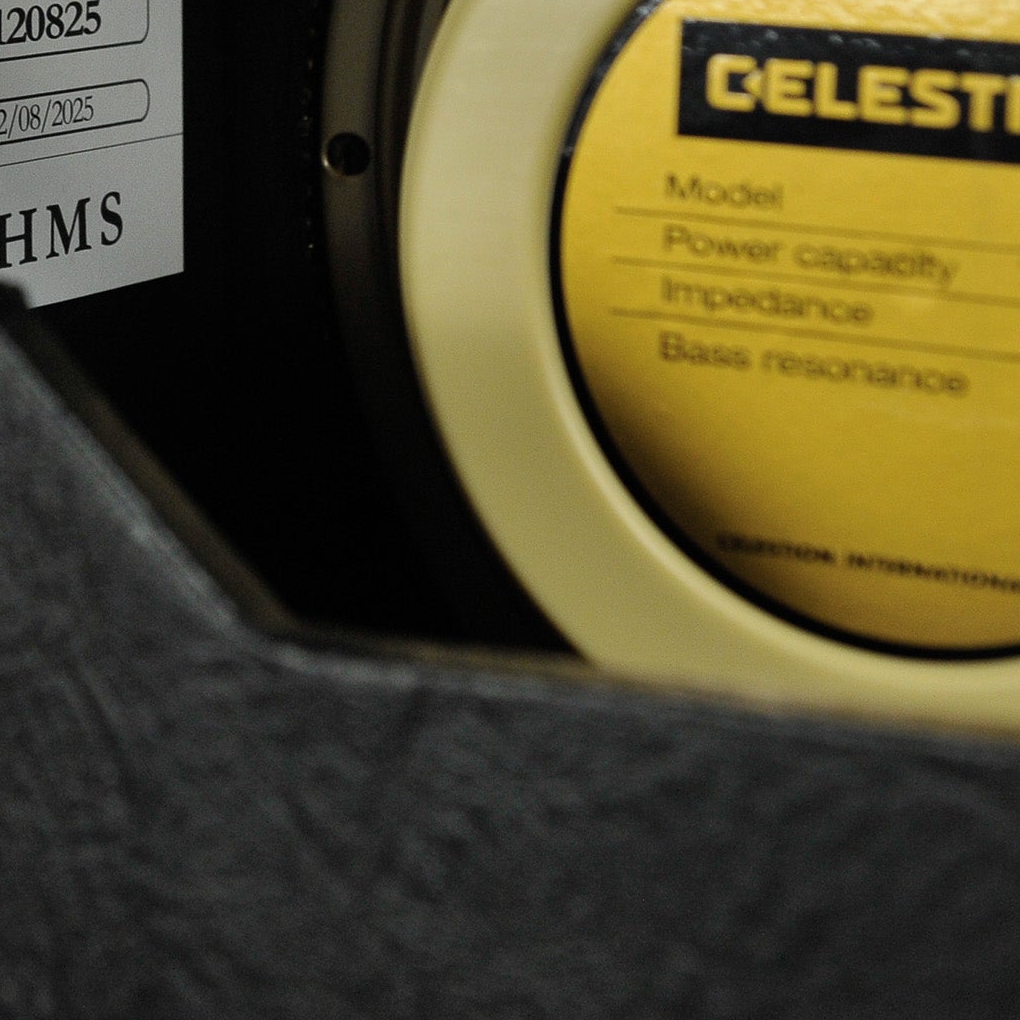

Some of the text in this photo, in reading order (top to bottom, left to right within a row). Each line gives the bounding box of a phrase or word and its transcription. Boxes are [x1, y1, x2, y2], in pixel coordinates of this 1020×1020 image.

[664, 173, 783, 210] Model
[663, 223, 959, 285] Power capacity
[661, 275, 873, 325] Impedance
[659, 330, 970, 399] Bass resonance
